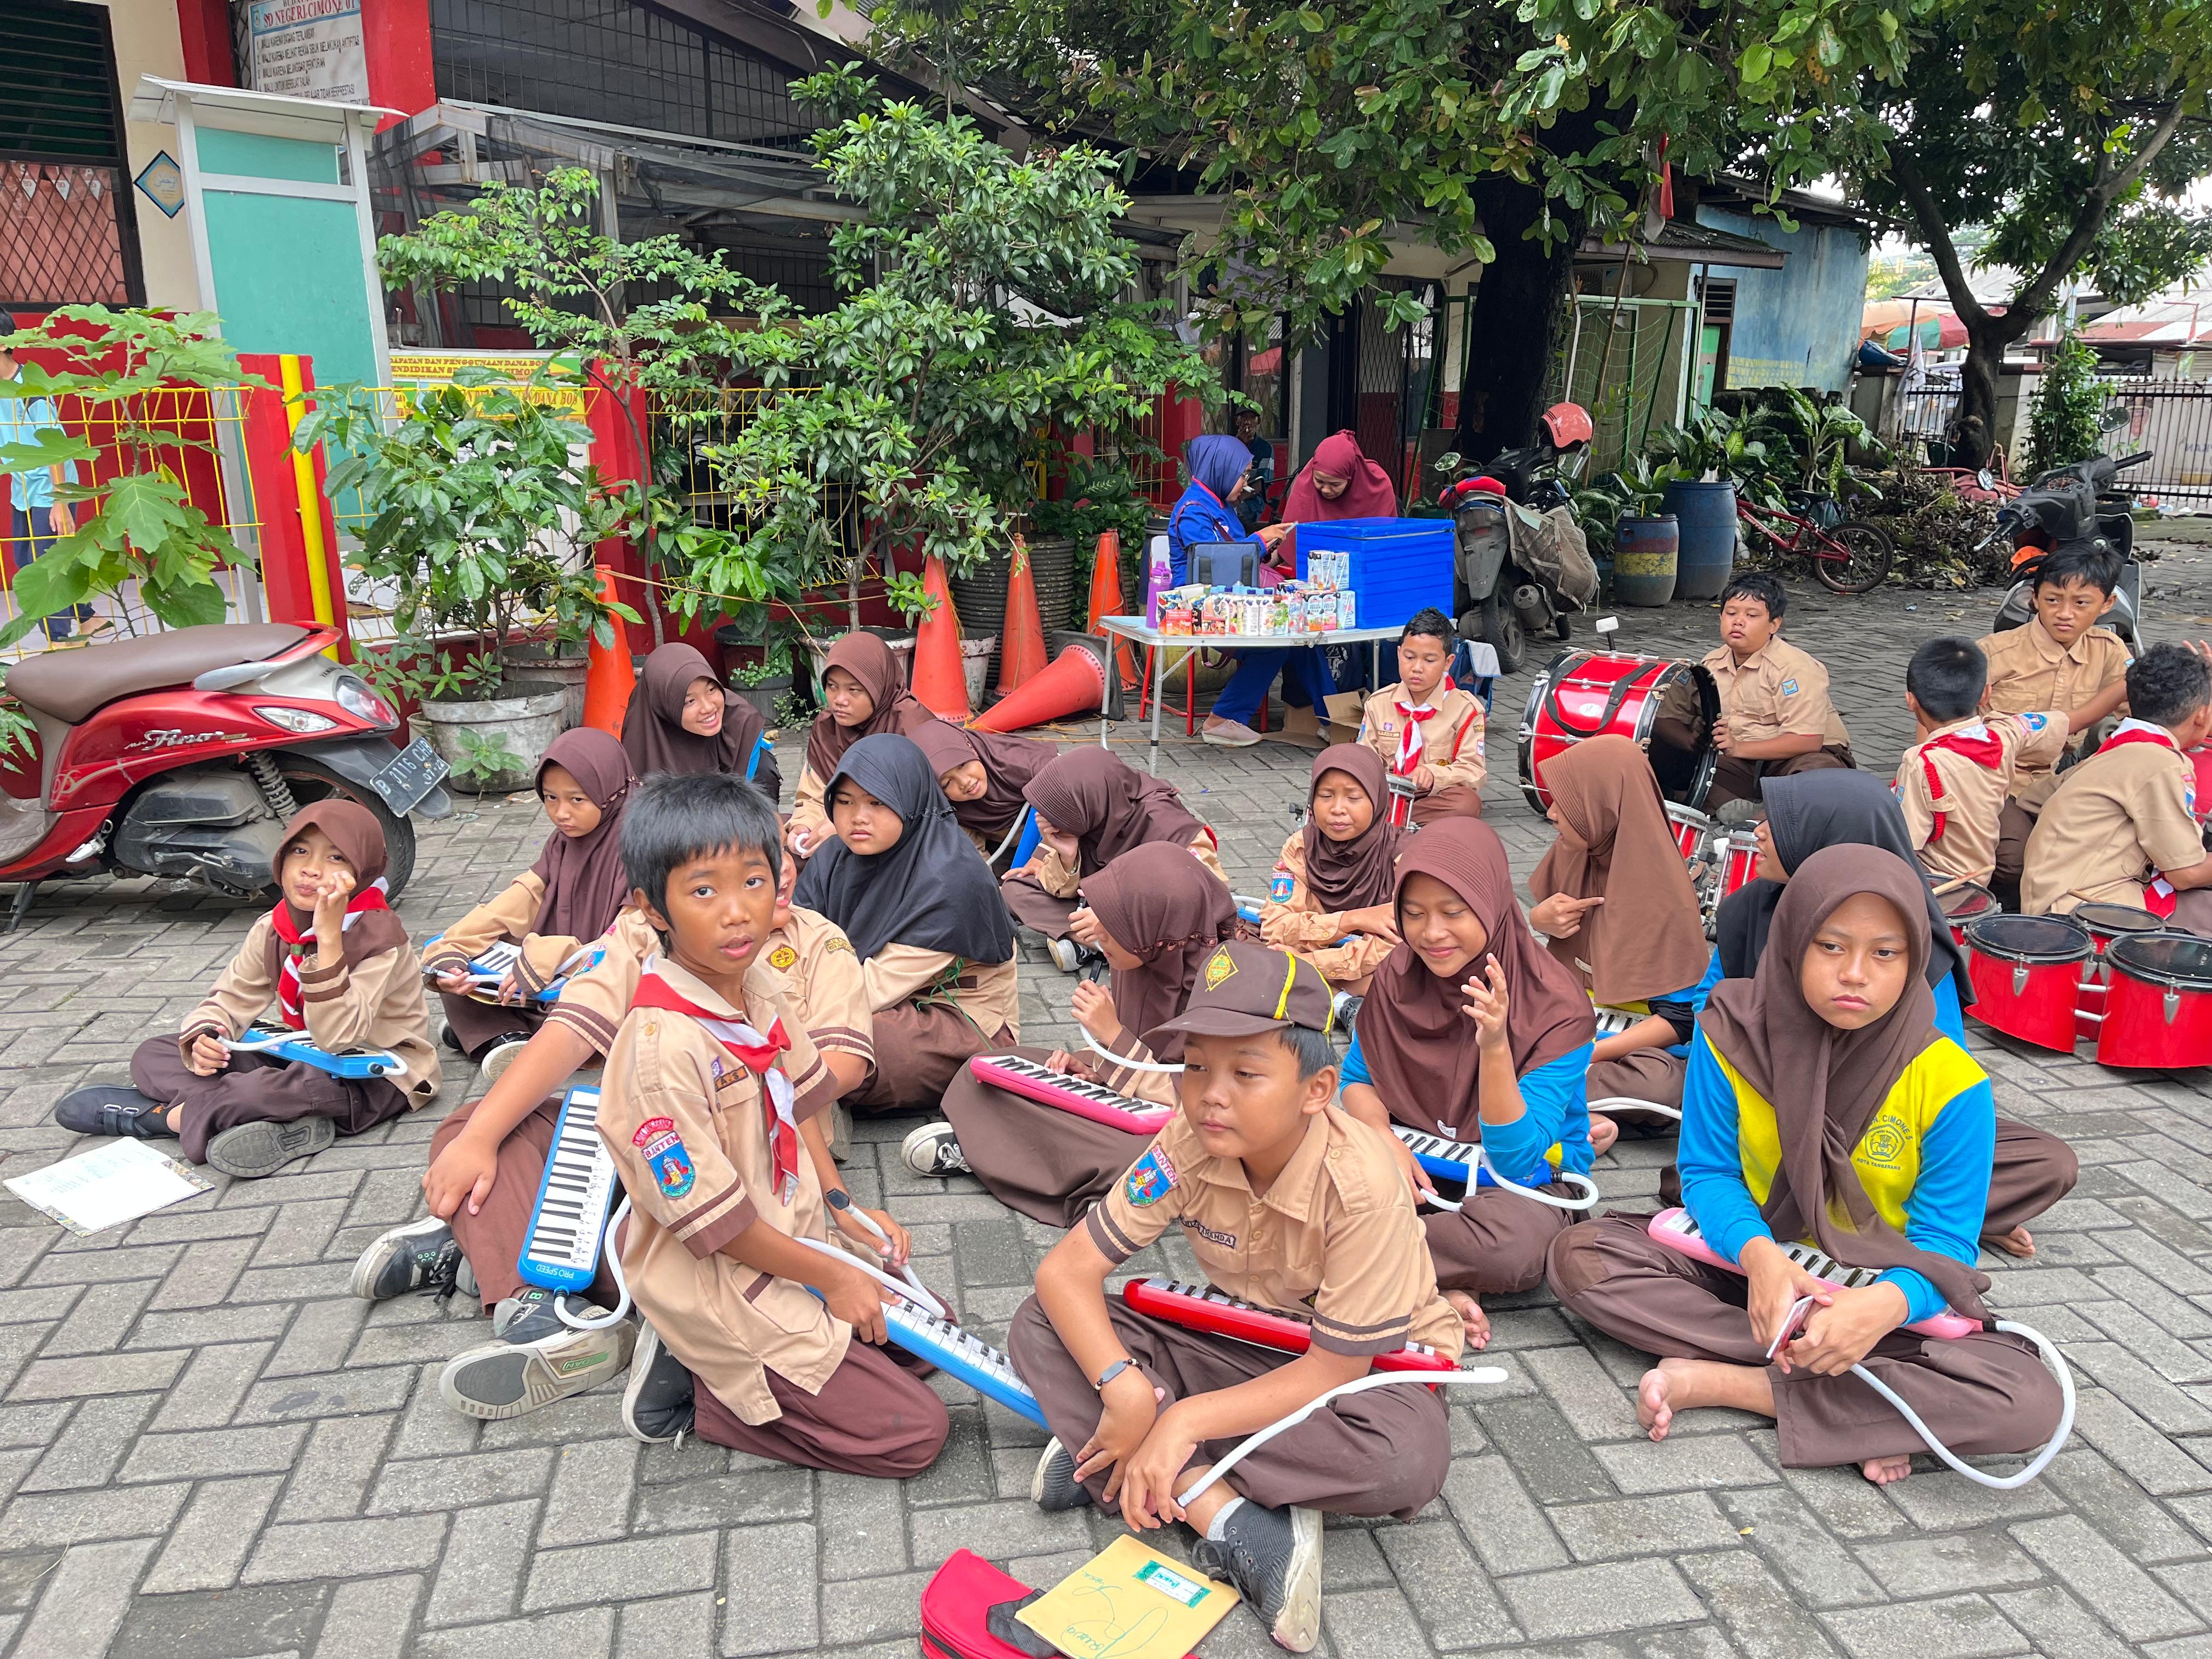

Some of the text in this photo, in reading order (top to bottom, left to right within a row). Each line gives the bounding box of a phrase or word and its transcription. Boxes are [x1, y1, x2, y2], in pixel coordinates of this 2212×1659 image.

[264, 13, 273, 27] SD
[275, 4, 307, 25] NEGERI
[308, 0, 343, 17] CIMONE
[534, 392, 557, 404] DANA
[375, 779, 392, 795] B
[411, 740, 433, 762] CHB
[1882, 1114, 1911, 1135] CIMONE
[645, 1134, 680, 1158] BANTEN
[1153, 1144, 1178, 1184] BANTEN
[1857, 1158, 1901, 1171] KOTA TANGERANG
[535, 1263, 575, 1279] PRO SPEED
